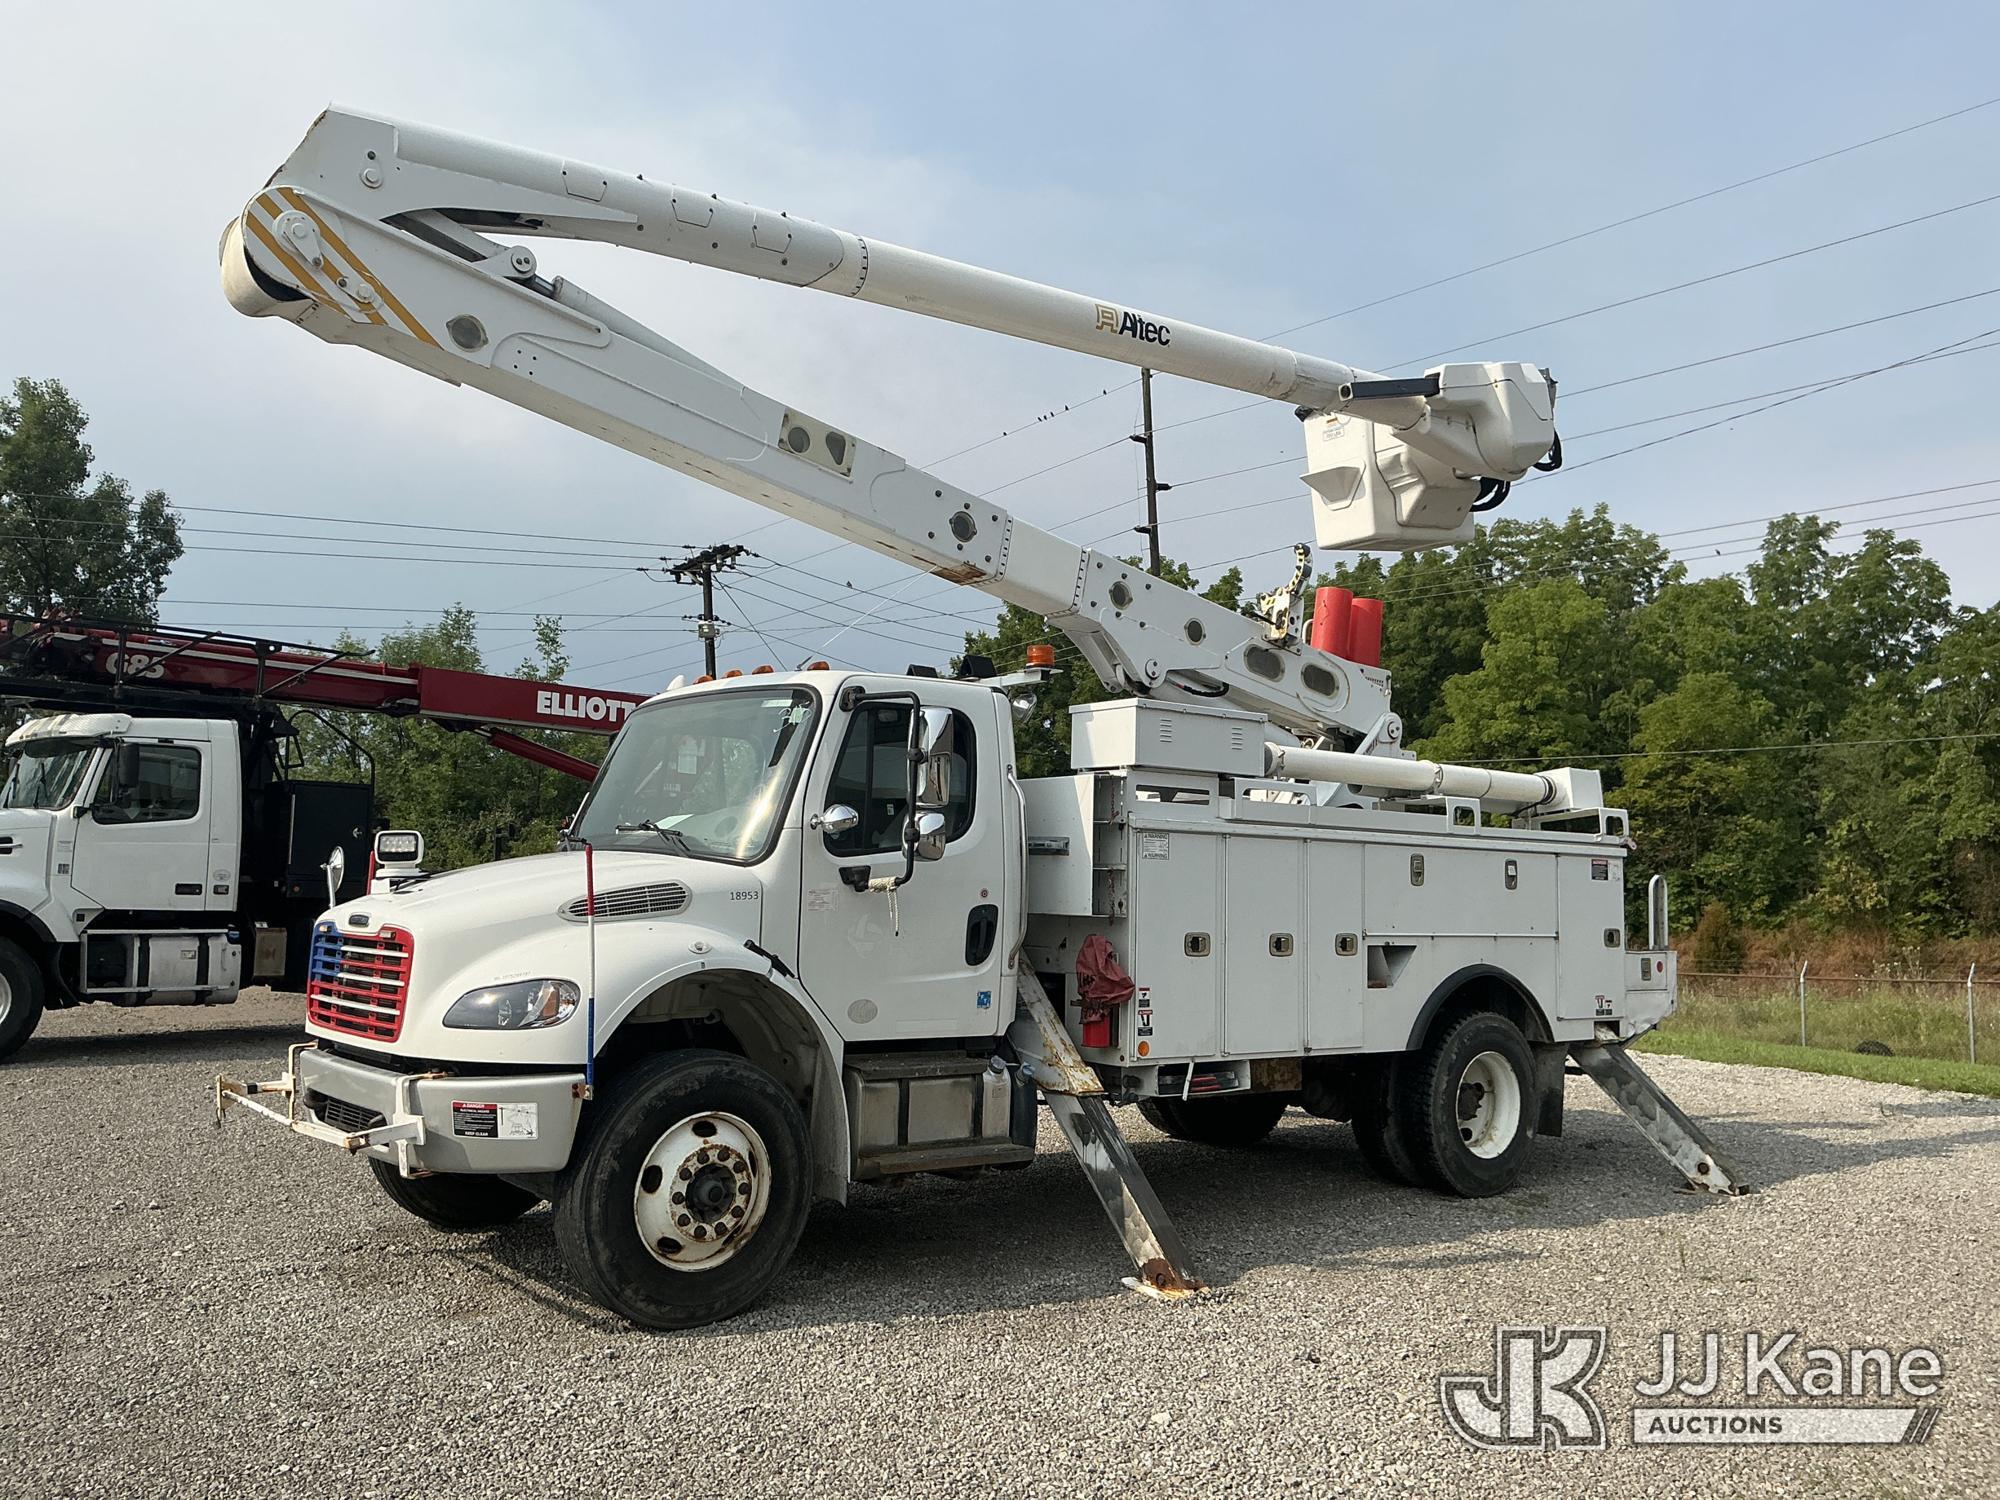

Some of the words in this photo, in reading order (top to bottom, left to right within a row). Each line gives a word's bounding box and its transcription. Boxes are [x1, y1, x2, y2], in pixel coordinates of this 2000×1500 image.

[1119, 311, 1171, 346] Altec
[106, 652, 165, 679] G85
[537, 690, 636, 722] ELLIOTT
[730, 891, 759, 901] 18953
